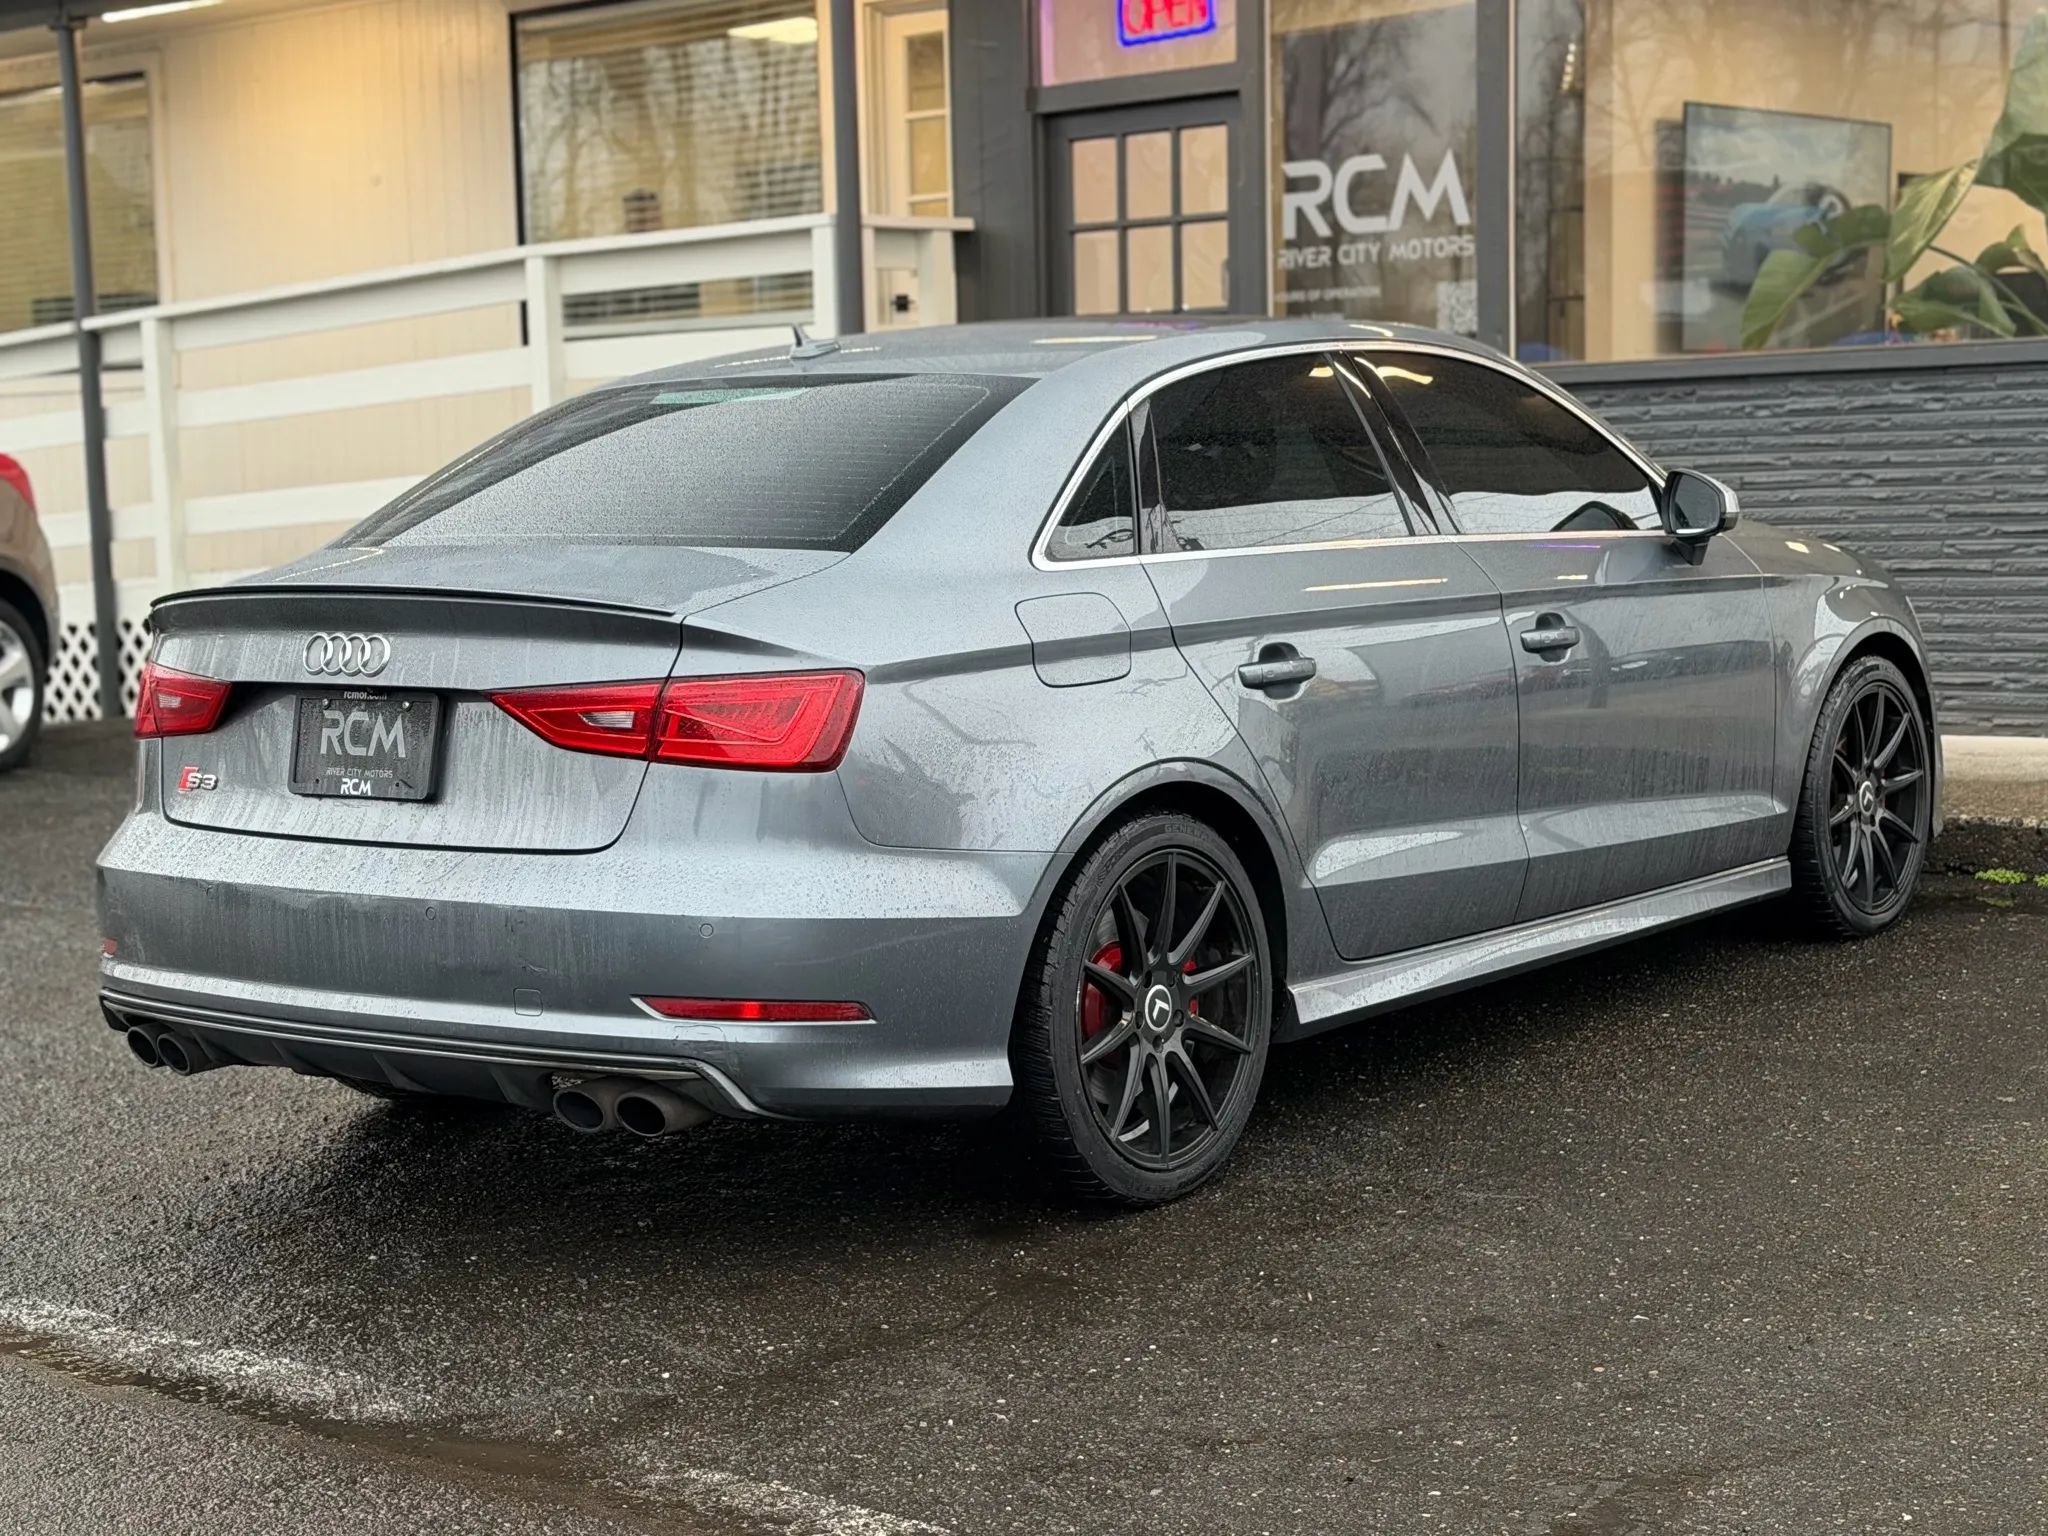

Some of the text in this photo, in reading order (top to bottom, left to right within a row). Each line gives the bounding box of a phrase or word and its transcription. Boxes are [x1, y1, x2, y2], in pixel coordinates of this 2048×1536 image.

[1281, 148, 1471, 240] RCM
[1278, 235, 1475, 270] RIVER CITY MOTORS
[320, 710, 406, 758] RCM
[186, 771, 218, 791] S3
[326, 767, 393, 779] RIVER CITY MOTORS
[341, 778, 371, 796] RCM
